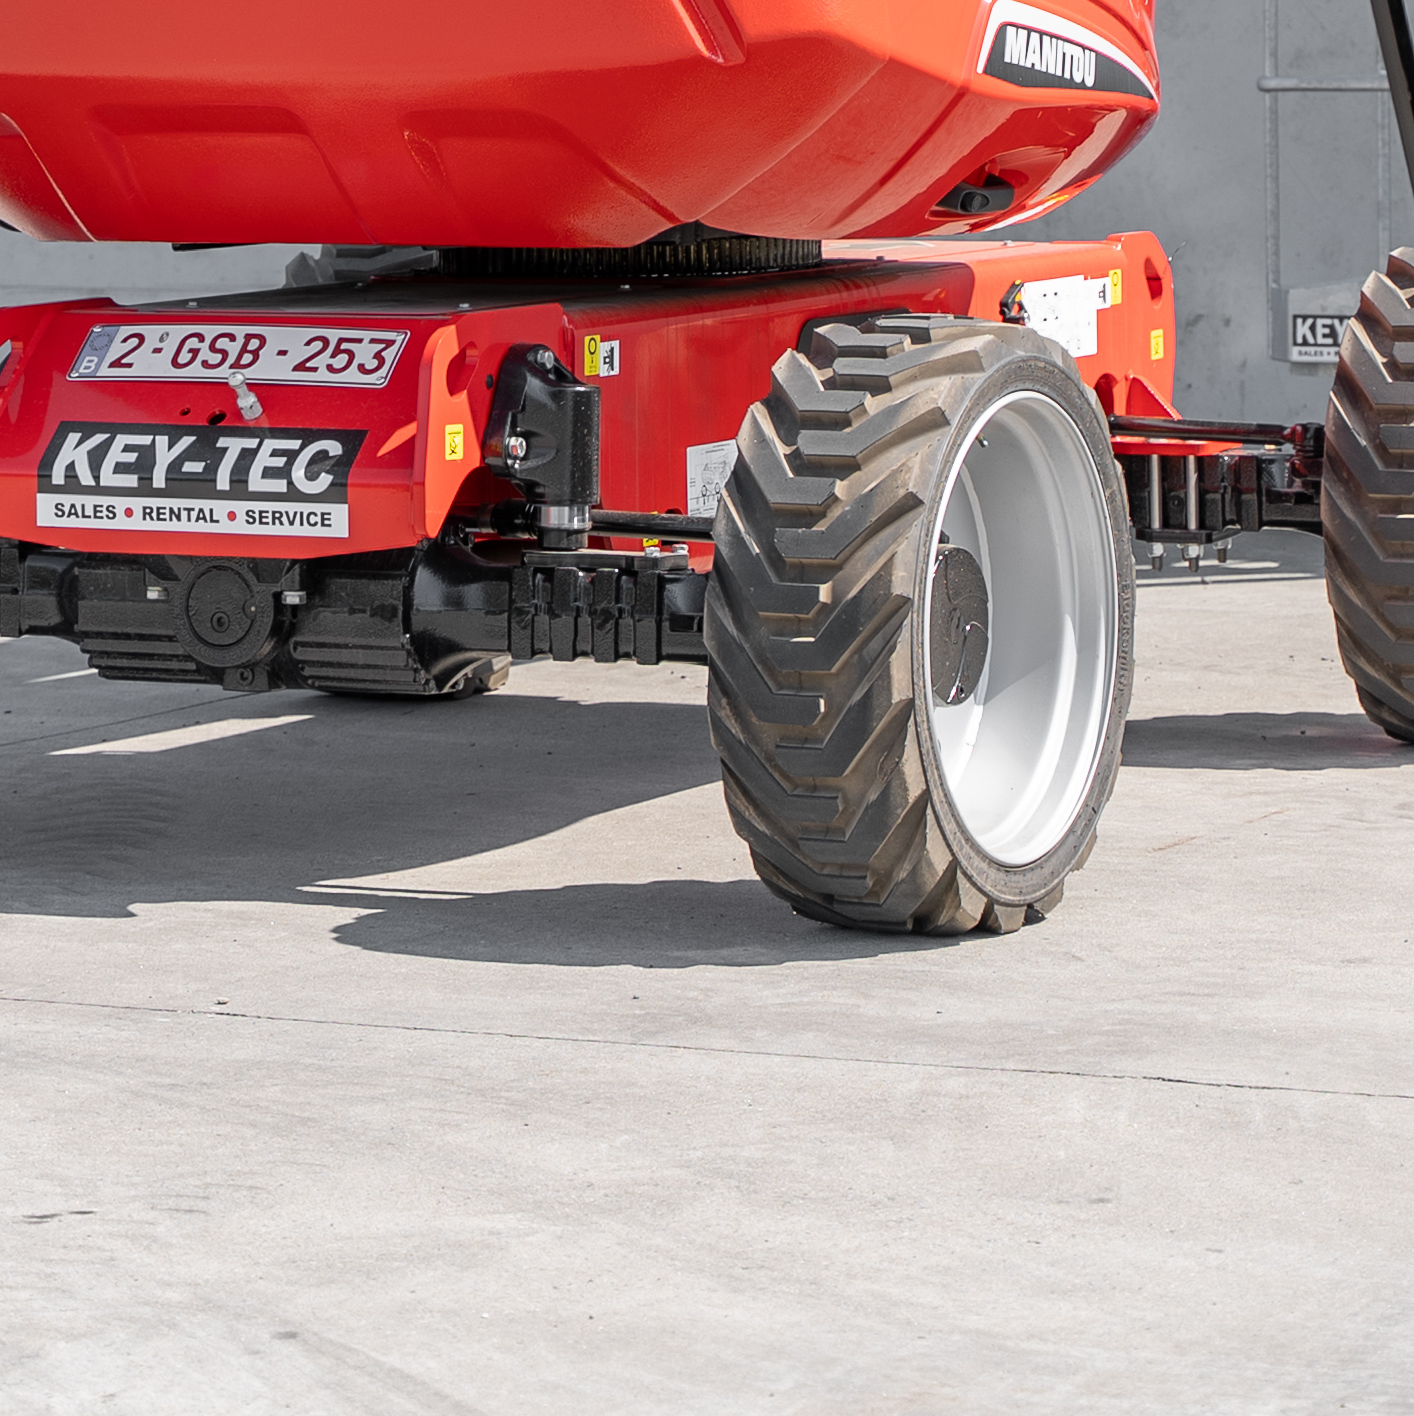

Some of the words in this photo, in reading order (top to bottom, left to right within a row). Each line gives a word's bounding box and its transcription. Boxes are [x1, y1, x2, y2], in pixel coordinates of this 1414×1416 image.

[1003, 24, 1097, 88] MANITOU
[78, 355, 98, 374] B
[50, 432, 344, 496] KEY-TEC
[53, 502, 118, 521] SALES
[141, 505, 220, 524] RENTAL
[244, 509, 333, 528] SERVICE
